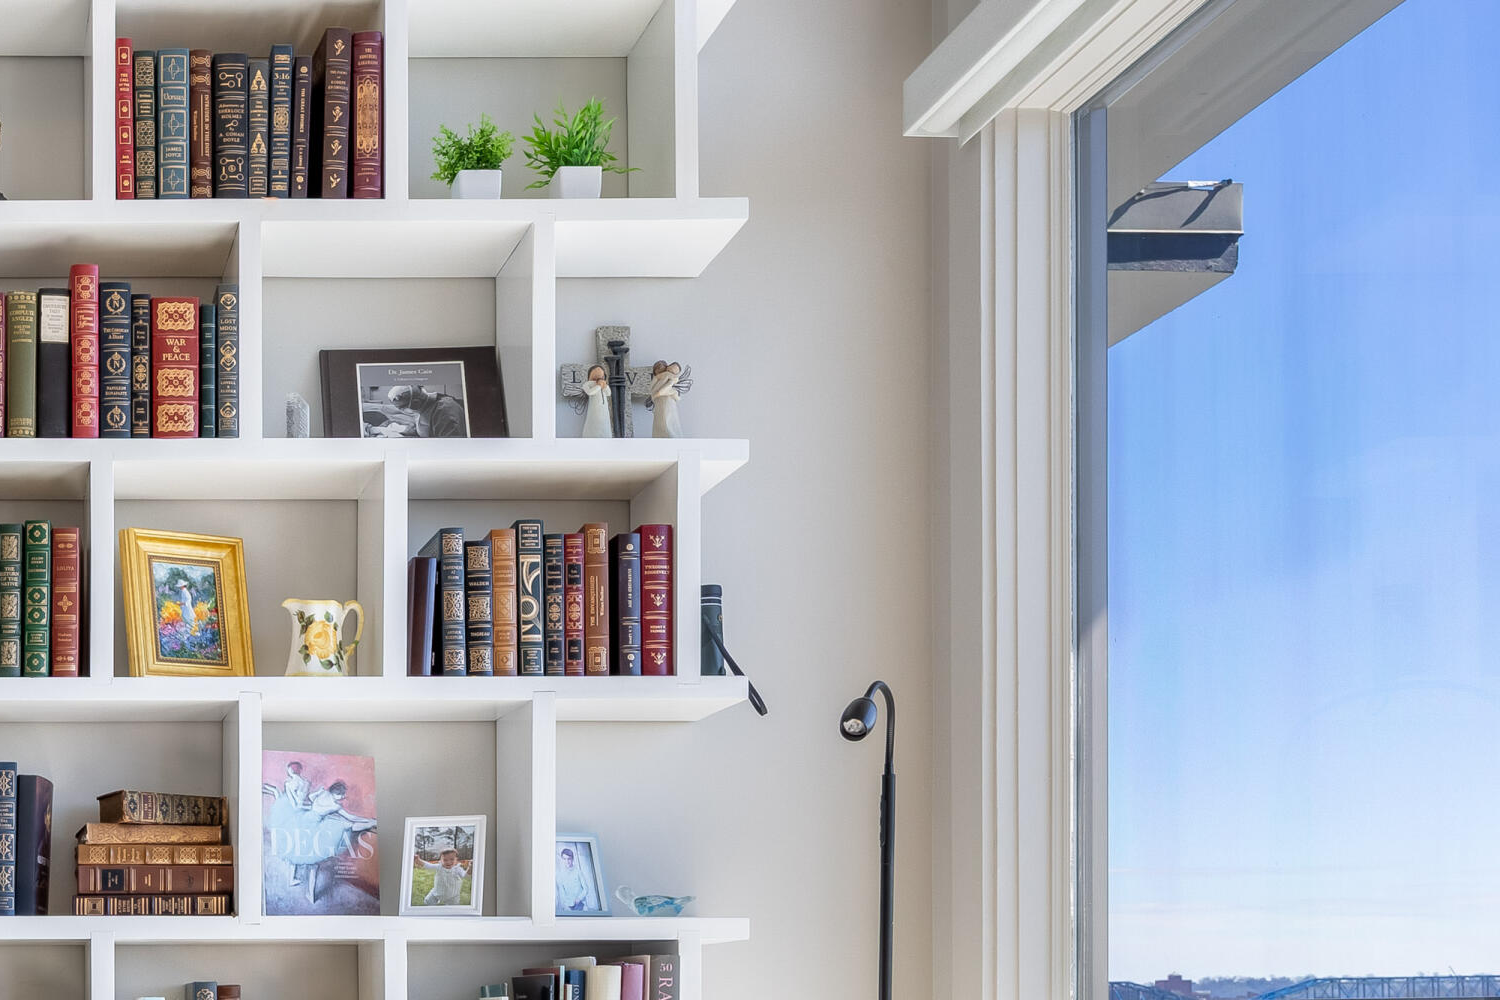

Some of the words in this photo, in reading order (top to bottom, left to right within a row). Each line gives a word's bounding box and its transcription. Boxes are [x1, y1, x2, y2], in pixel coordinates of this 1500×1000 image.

[274, 72, 290, 80] 3:16
[165, 338, 186, 346] WAR
[162, 353, 190, 361] PEACE
[270, 828, 374, 861] DEGAS
[659, 963, 673, 972] 50
